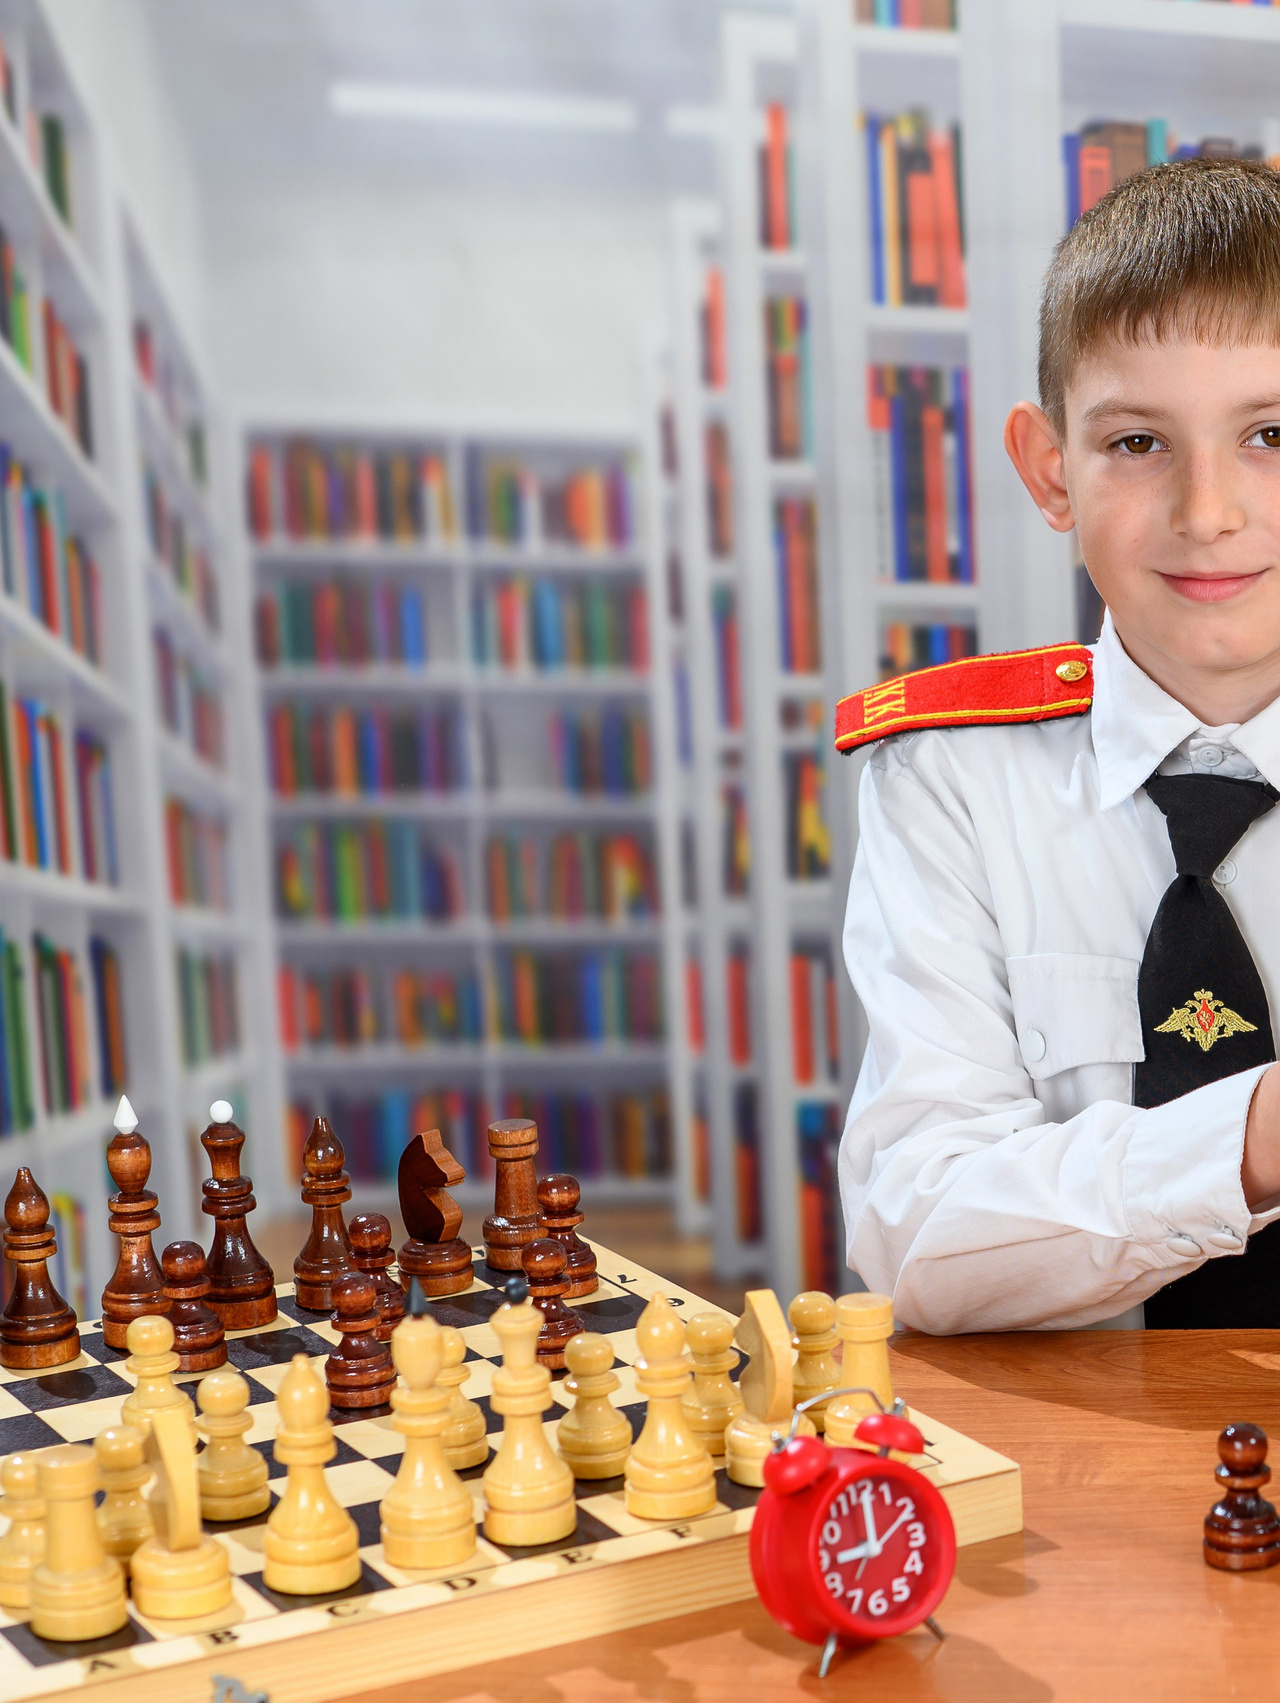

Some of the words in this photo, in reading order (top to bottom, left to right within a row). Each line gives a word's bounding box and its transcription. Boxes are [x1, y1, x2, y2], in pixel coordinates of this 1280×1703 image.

[878, 1482, 893, 1506] 1
[896, 1496, 916, 1521] 2
[906, 1521, 927, 1548] 3
[903, 1549, 924, 1576] 4
[88, 1658, 118, 1674] A
[206, 1630, 240, 1646] B
[326, 1603, 360, 1618] C
[442, 1576, 478, 1592] D
[558, 1549, 594, 1565] E
[668, 1524, 693, 1540] F
[846, 1587, 864, 1615] 7
[867, 1588, 889, 1616] 6
[891, 1576, 911, 1603] 5
